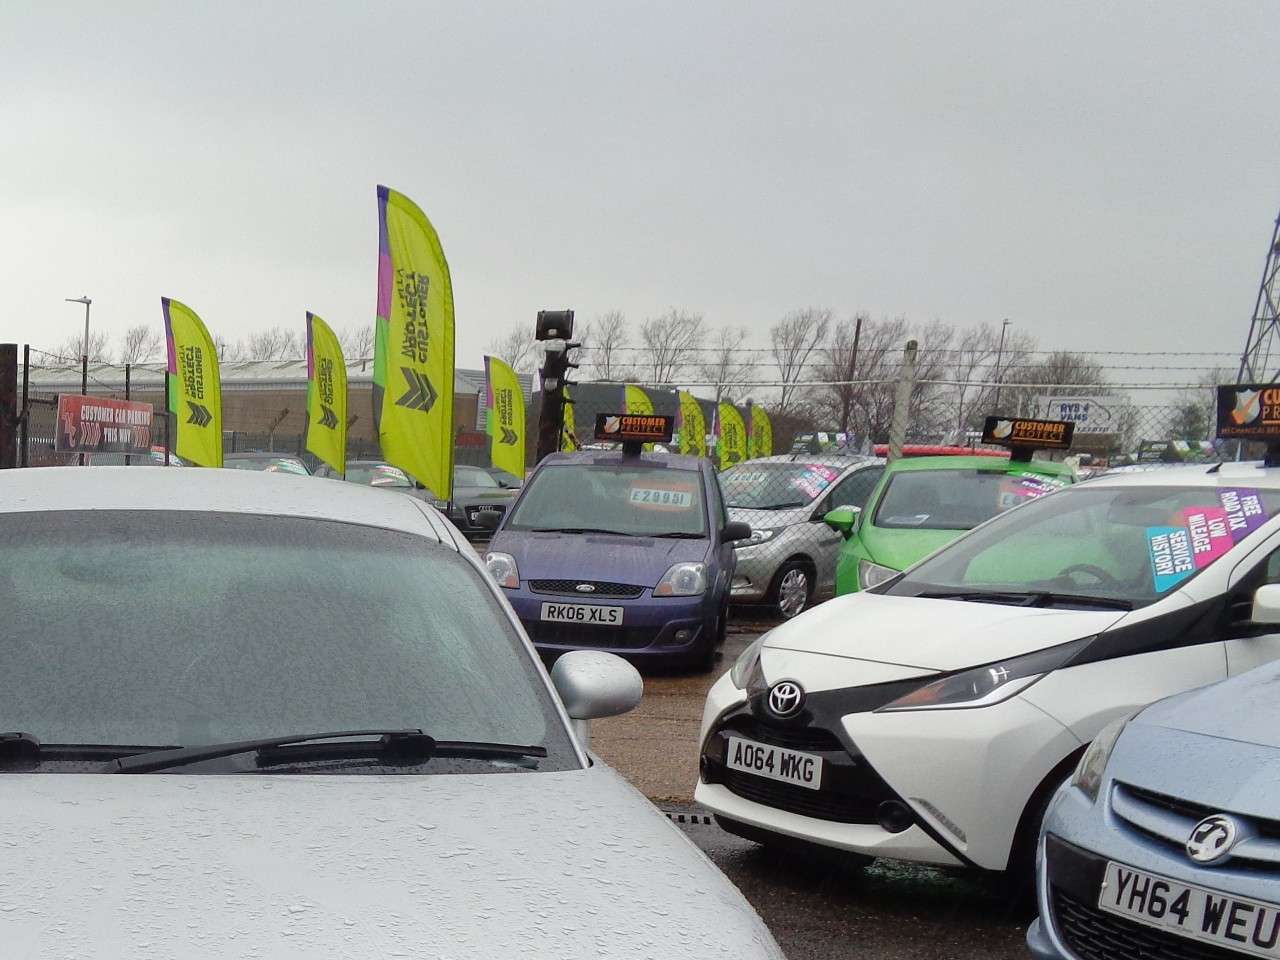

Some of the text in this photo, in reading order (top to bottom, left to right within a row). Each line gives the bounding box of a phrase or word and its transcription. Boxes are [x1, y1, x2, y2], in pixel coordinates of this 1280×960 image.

[81, 405, 151, 426] CUSTOMER CAR PARKING
[622, 417, 666, 426] CUSTOMER
[103, 427, 132, 443] THIS WAY
[1013, 430, 1064, 440] PROTECT
[1015, 421, 1065, 433] CUSTOMER
[1221, 491, 1248, 531] ROAD TAX
[1241, 494, 1263, 517] FREE
[1188, 513, 1212, 554] MILEAGE
[1208, 518, 1228, 538] LOW
[1151, 534, 1174, 576] HISTORY
[1169, 530, 1193, 573] SERVICE
[547, 605, 617, 622] RK06 XLS
[734, 741, 814, 782] AO64 WKG
[1116, 868, 1280, 949] YH64 WEU
